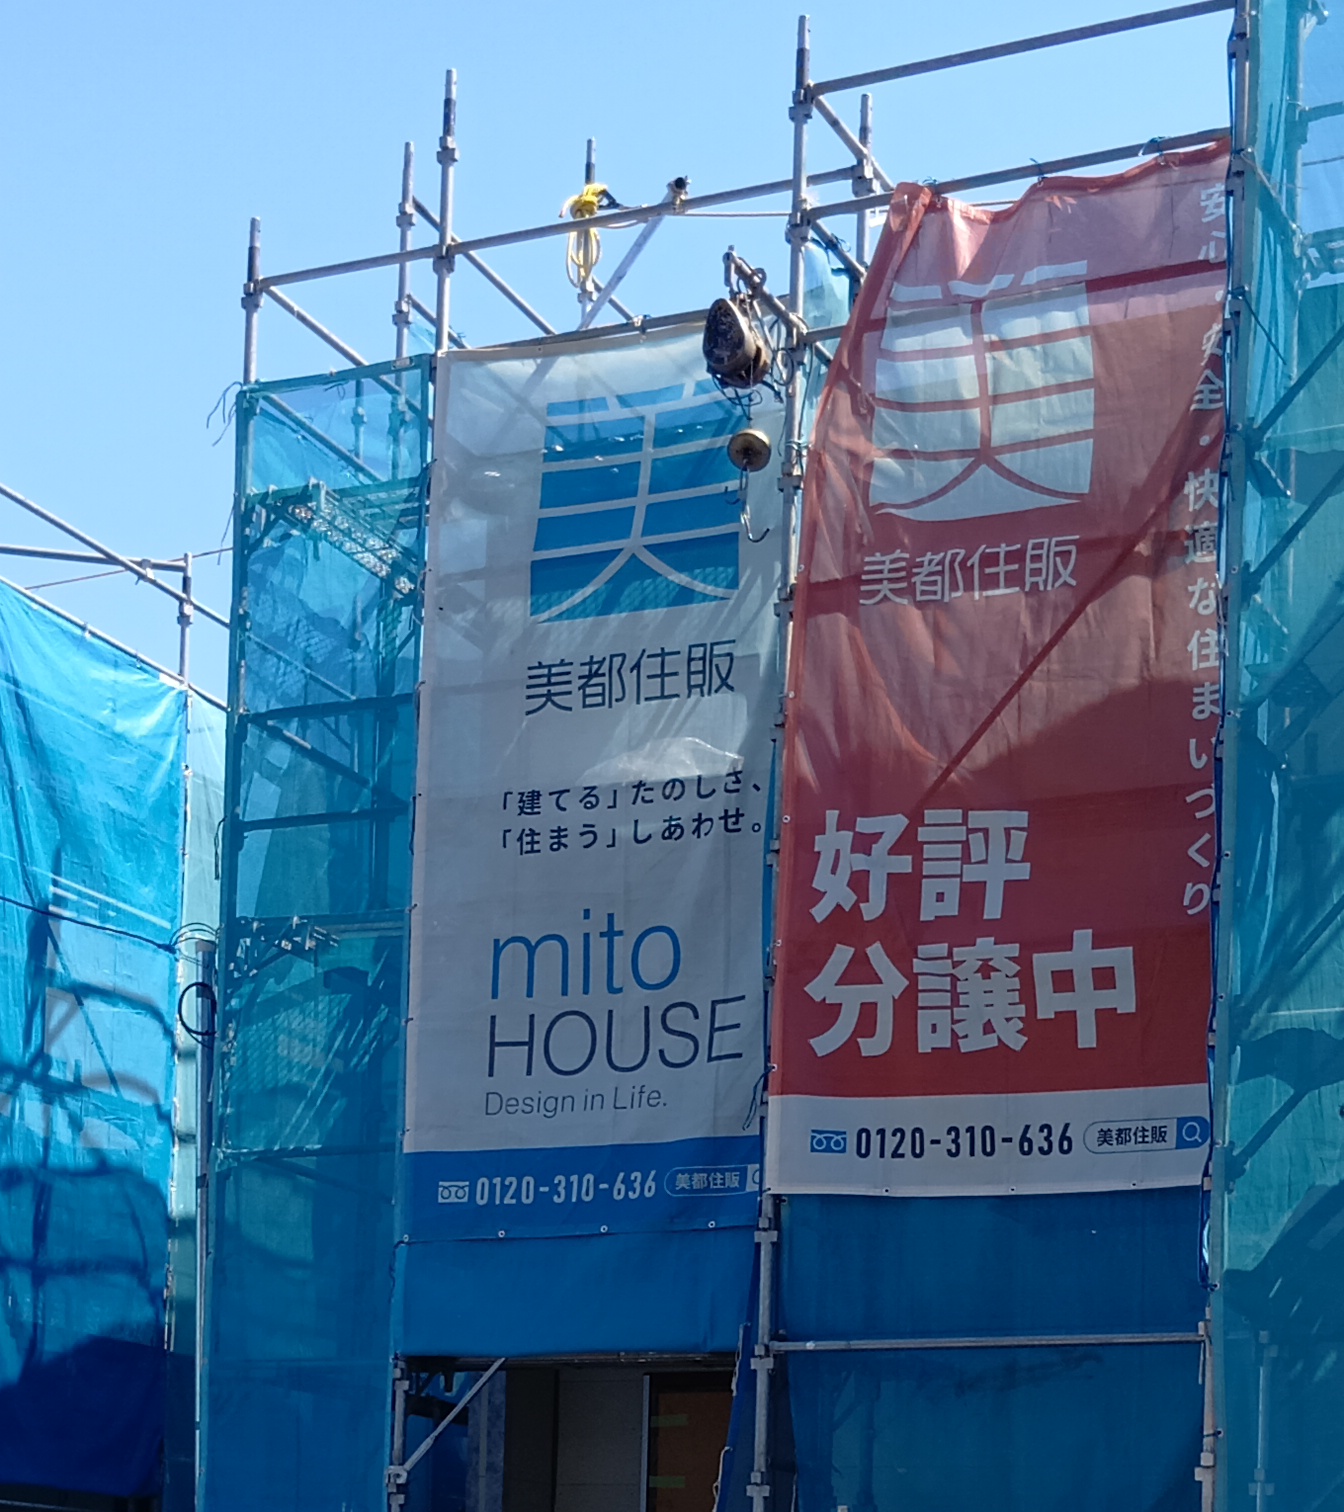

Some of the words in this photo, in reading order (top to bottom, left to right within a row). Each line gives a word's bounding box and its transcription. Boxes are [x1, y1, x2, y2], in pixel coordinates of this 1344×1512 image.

[860, 535, 1079, 606] 美都住販
[524, 639, 737, 717] 美都住販
[502, 769, 762, 817] 「建てる」たのしさ、
[502, 807, 762, 856] 「住まう」しあわせ。
[810, 808, 1031, 923] 好評
[491, 907, 682, 1001] mito
[804, 929, 1137, 1057] 分譲中
[486, 994, 746, 1079] HOUSE
[484, 1091, 576, 1118] Design
[583, 1090, 606, 1113] in
[613, 1084, 668, 1111] Life.
[856, 1121, 1074, 1162] 0120-310-636
[1096, 1122, 1168, 1149] 美都住販
[476, 1169, 656, 1206] 0120-310-636
[674, 1171, 741, 1191] 美都住販
